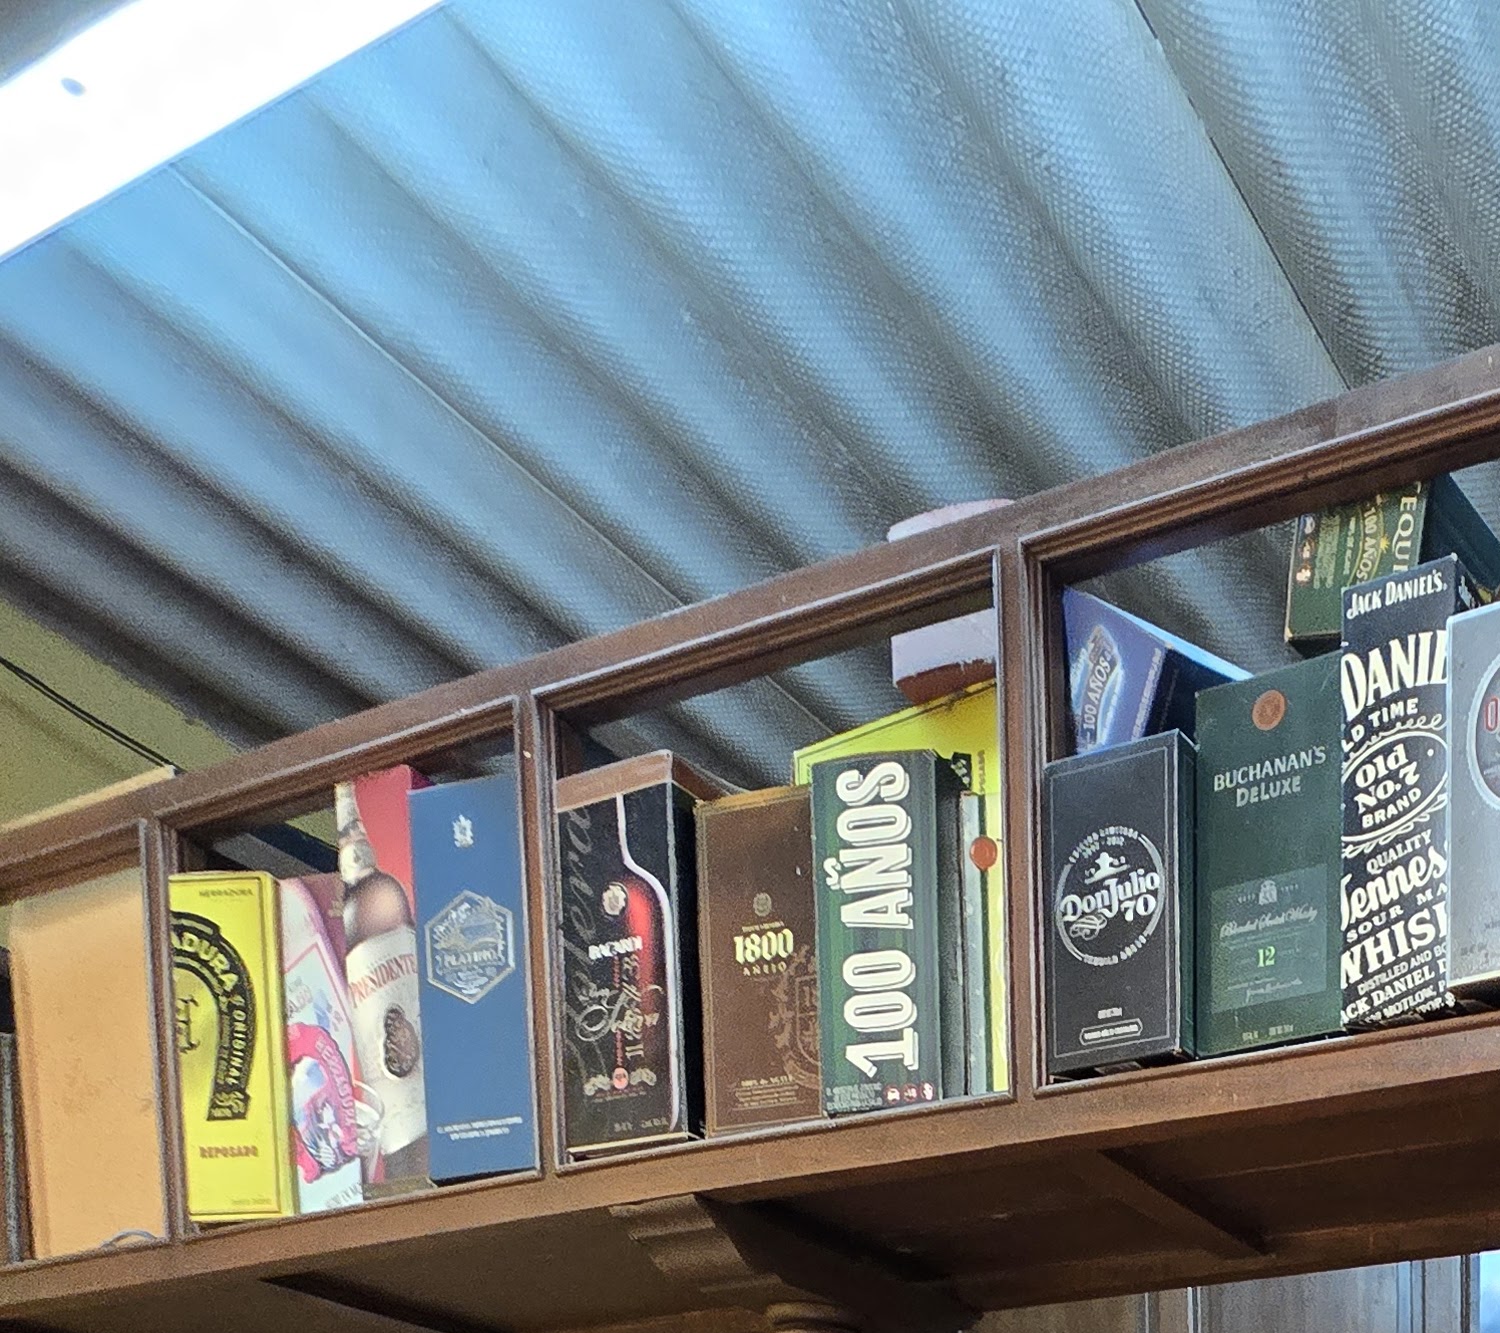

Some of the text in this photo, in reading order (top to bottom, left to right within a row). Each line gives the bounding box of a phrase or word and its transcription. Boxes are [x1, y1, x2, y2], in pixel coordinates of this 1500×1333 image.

[1347, 570, 1444, 620] JACK DANIEL'S
[1082, 703, 1098, 732] 100
[1368, 697, 1418, 729] TIME
[1213, 746, 1328, 793] BUCHANAN'S
[1355, 743, 1408, 788] Old
[1235, 776, 1302, 808] DELUXE
[1362, 787, 1422, 828] BRAND
[823, 761, 915, 930] AÑOS
[1366, 829, 1432, 875] QUALITY
[1120, 893, 1157, 922] 70
[1346, 905, 1404, 943] SOUR
[733, 928, 794, 965] 1800
[1257, 945, 1276, 968] 12
[1357, 958, 1409, 995] DISTILLED
[1410, 949, 1433, 970] AND
[1371, 965, 1436, 1007] DANIEL
[842, 949, 919, 1078] 100
[199, 1145, 258, 1159] REPOSADO
